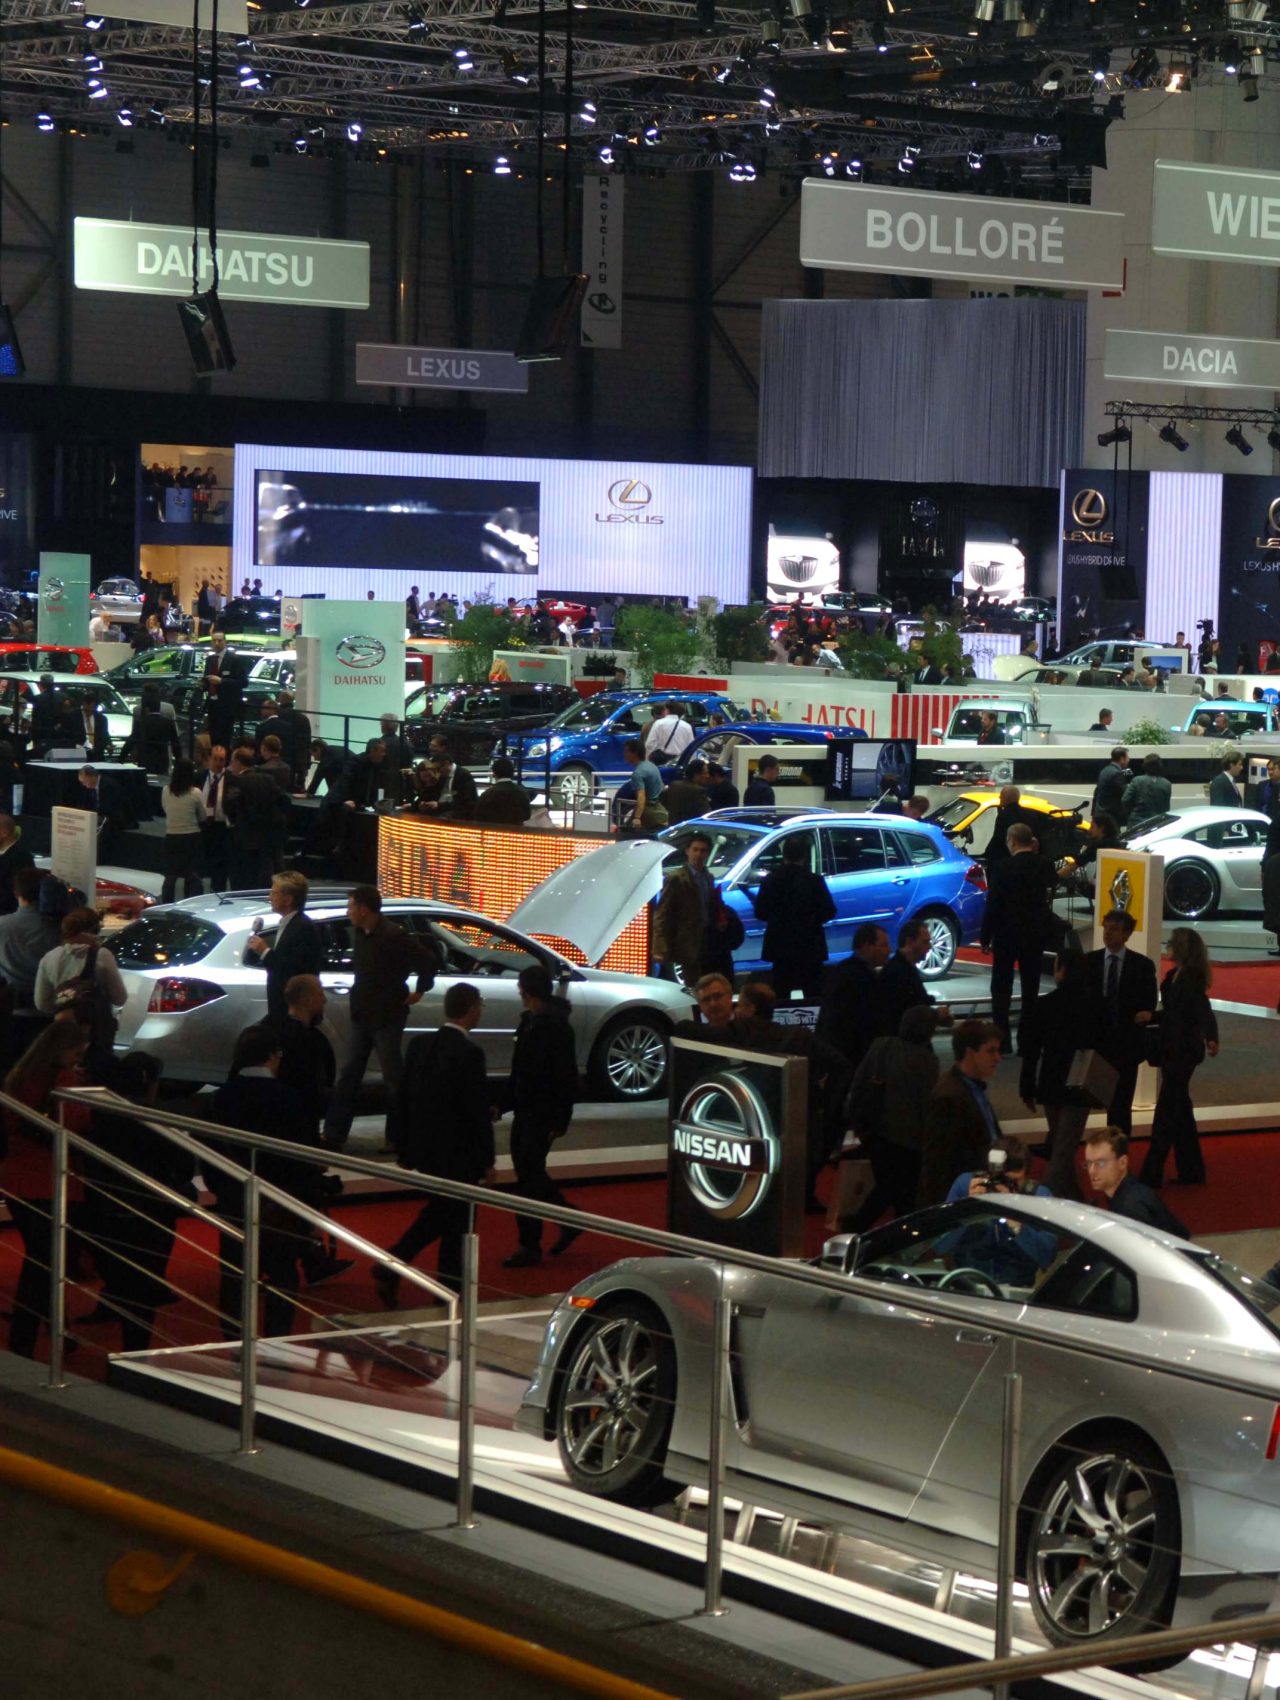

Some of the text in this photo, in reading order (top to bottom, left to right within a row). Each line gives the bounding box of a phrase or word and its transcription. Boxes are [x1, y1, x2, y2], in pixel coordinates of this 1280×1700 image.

[599, 176, 610, 284] Recycling
[866, 208, 1066, 264] BOLLORÉ
[137, 241, 314, 288] DAIHATSU
[406, 356, 481, 381] LEXUS
[1163, 345, 1239, 375] DACIA
[594, 511, 665, 525] LEXUS
[1062, 529, 1115, 543] LEXUS
[334, 675, 387, 686] DAIHATSU
[751, 697, 876, 739] DAHATSU
[674, 1128, 752, 1167] NISSAN
